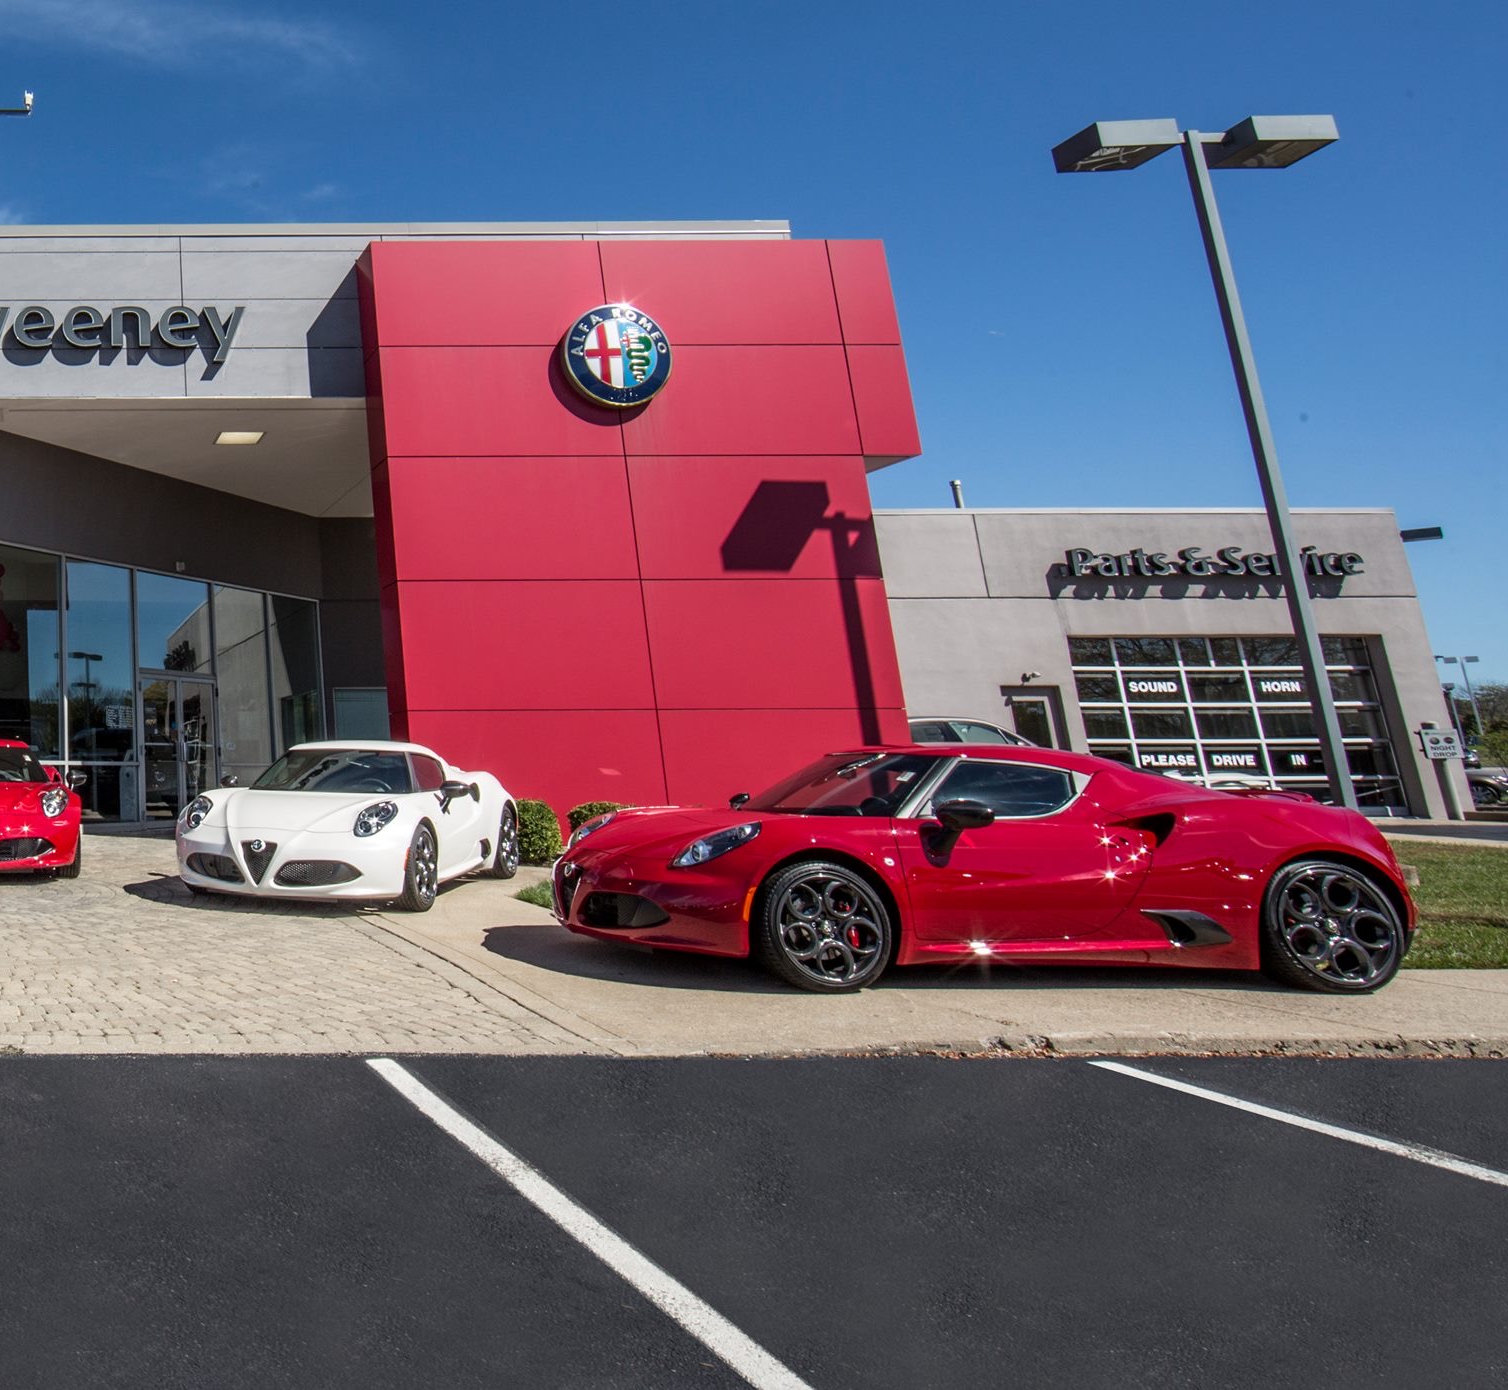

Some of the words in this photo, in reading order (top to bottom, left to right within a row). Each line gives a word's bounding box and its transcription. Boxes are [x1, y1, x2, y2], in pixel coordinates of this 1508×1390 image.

[570, 313, 604, 357] ALFA
[611, 308, 668, 354] ROMEO
[1066, 547, 1174, 577] Parts
[1179, 546, 1215, 577] &
[1217, 546, 1366, 577] Serice
[1128, 681, 1178, 693] SOUND
[1260, 681, 1302, 693] HORN
[1141, 754, 1198, 767] PLEASE
[1212, 754, 1257, 767] DRIVE
[1291, 754, 1308, 767] IN
